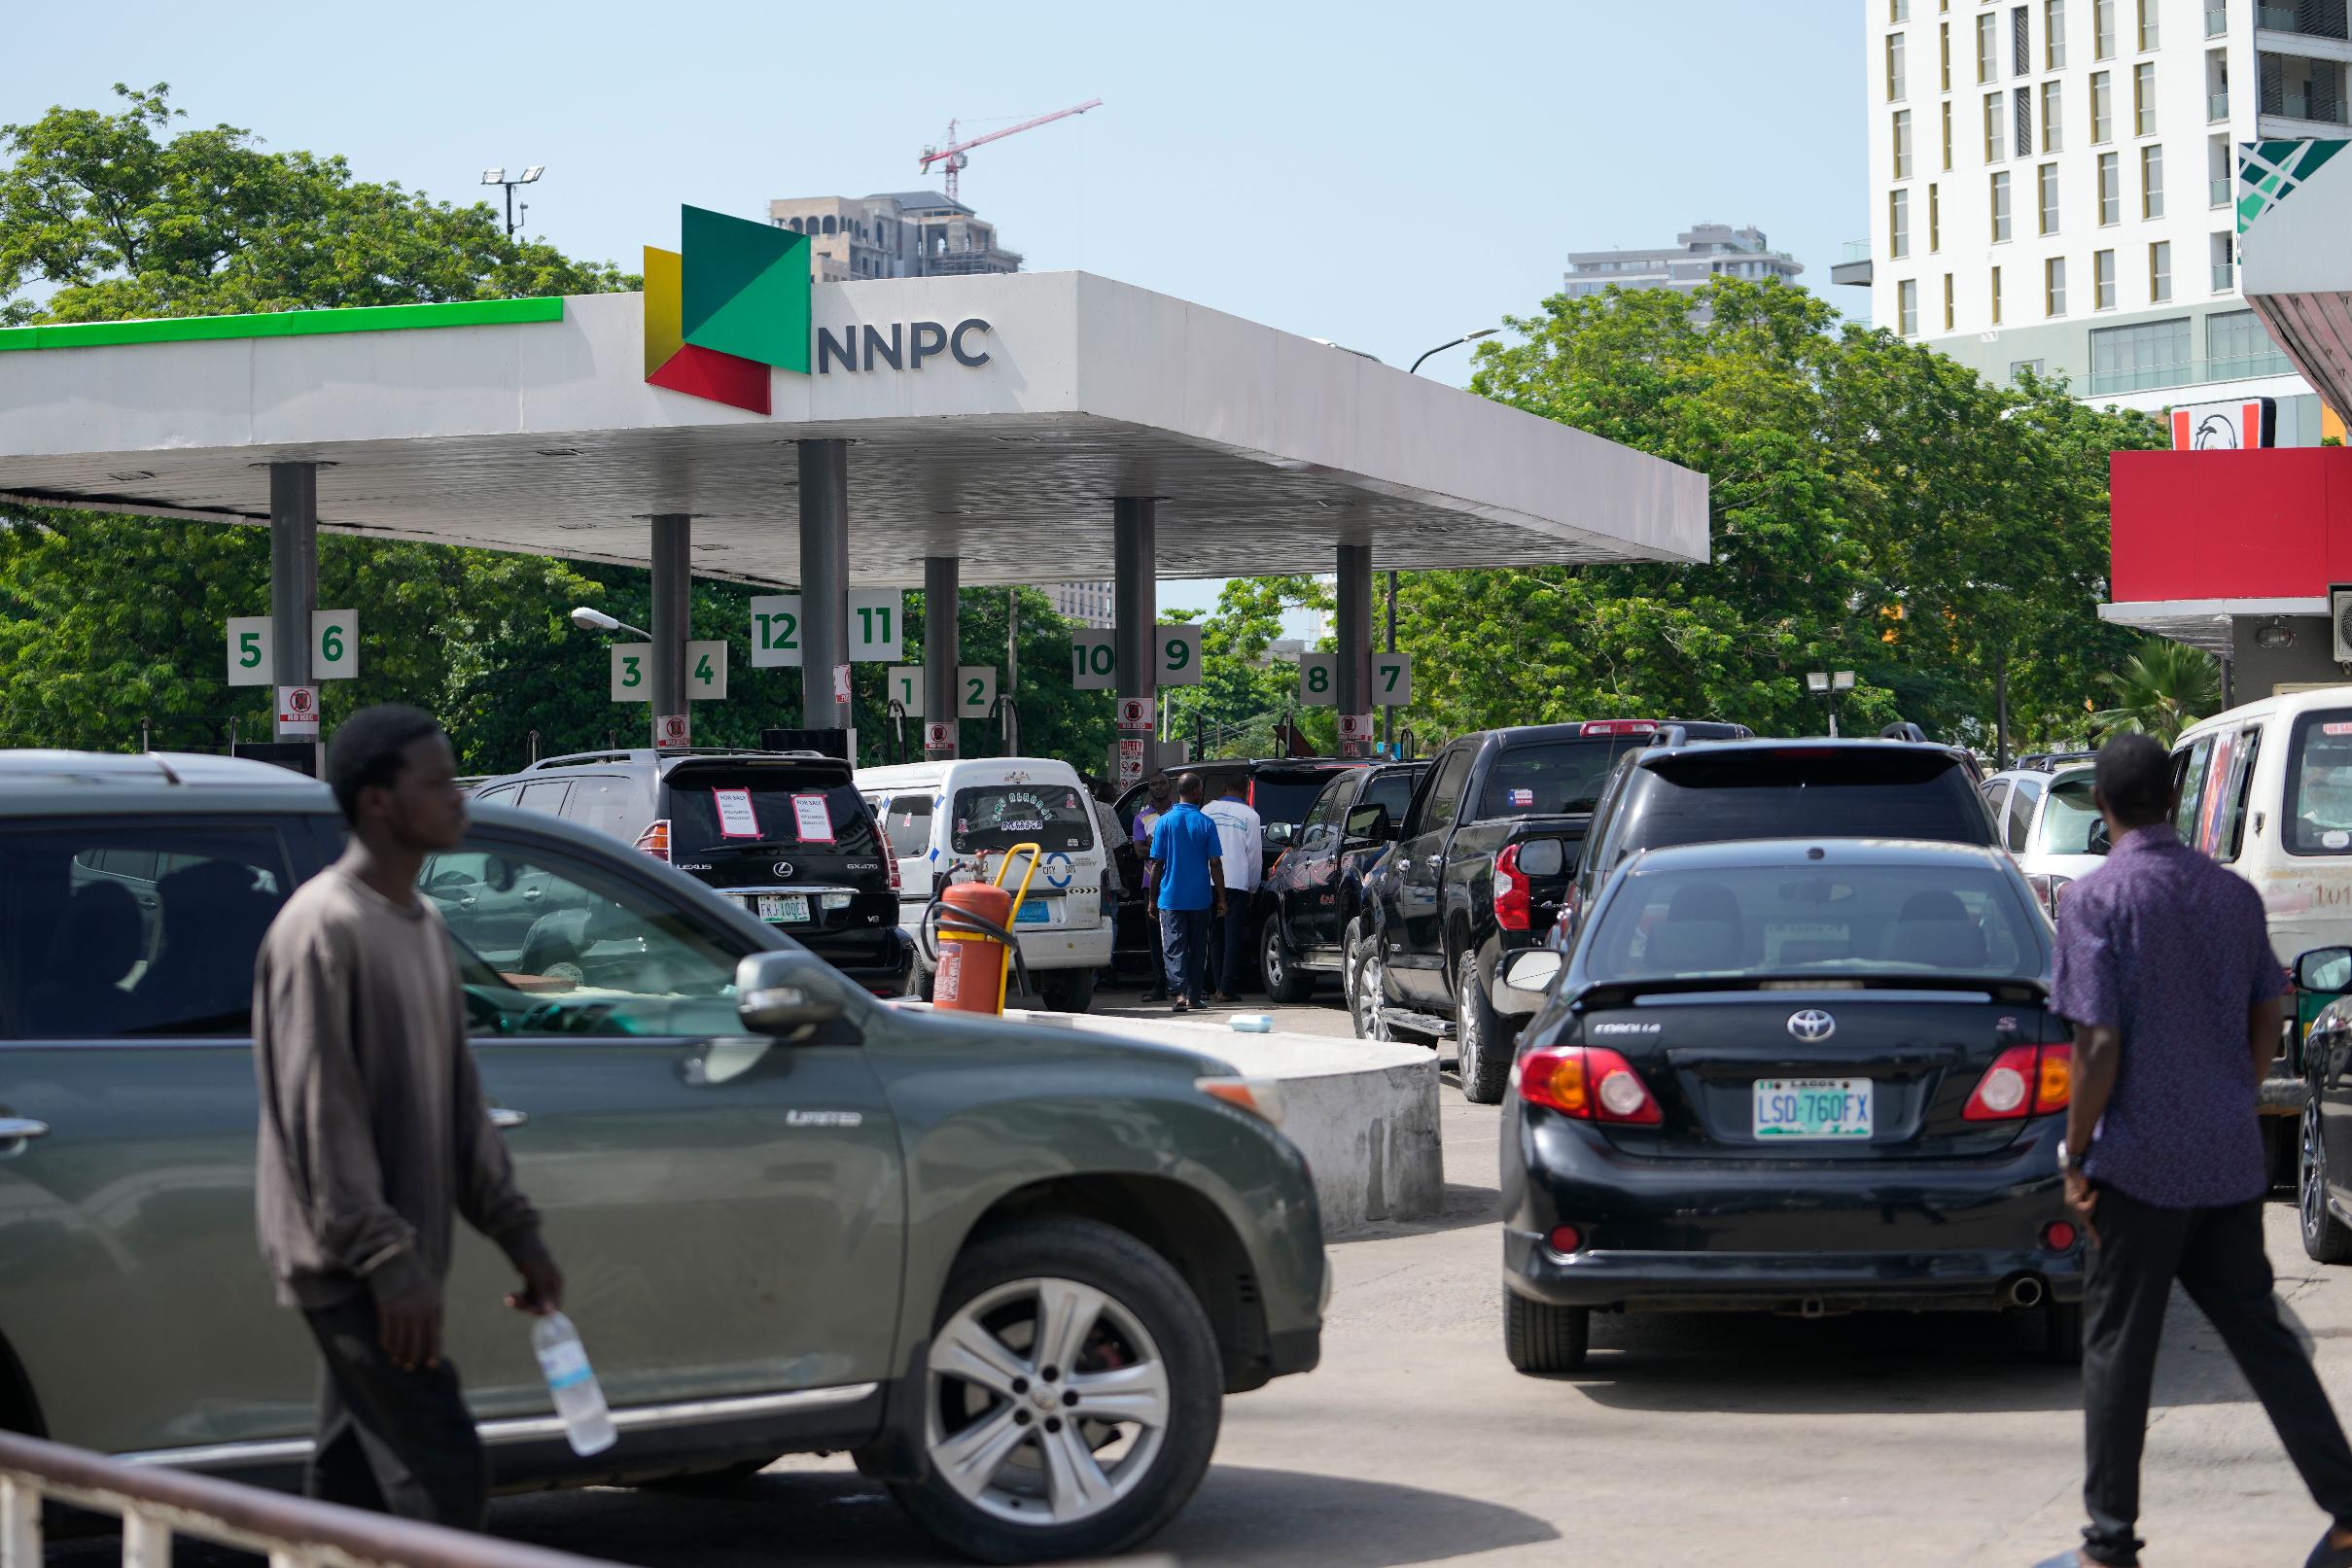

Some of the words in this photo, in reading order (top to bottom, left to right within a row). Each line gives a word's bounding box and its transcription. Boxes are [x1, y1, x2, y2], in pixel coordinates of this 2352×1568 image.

[818, 318, 992, 374] NNPC
[755, 612, 798, 649] 12
[857, 607, 892, 644] 11
[239, 632, 263, 669] 5
[322, 625, 343, 662] 6
[1165, 639, 1190, 671] 9
[621, 656, 642, 687] 3
[694, 654, 714, 685] 4
[1073, 645, 1115, 676] 10
[899, 678, 912, 705] 1
[966, 678, 985, 706] 2
[1308, 666, 1329, 693] 8
[1380, 665, 1401, 693] 7
[1120, 740, 1142, 751] SAFETY
[1042, 865, 1056, 875] CITY
[1995, 1016, 2018, 1031] S
[1758, 1095, 1868, 1124] LSD-760FX
